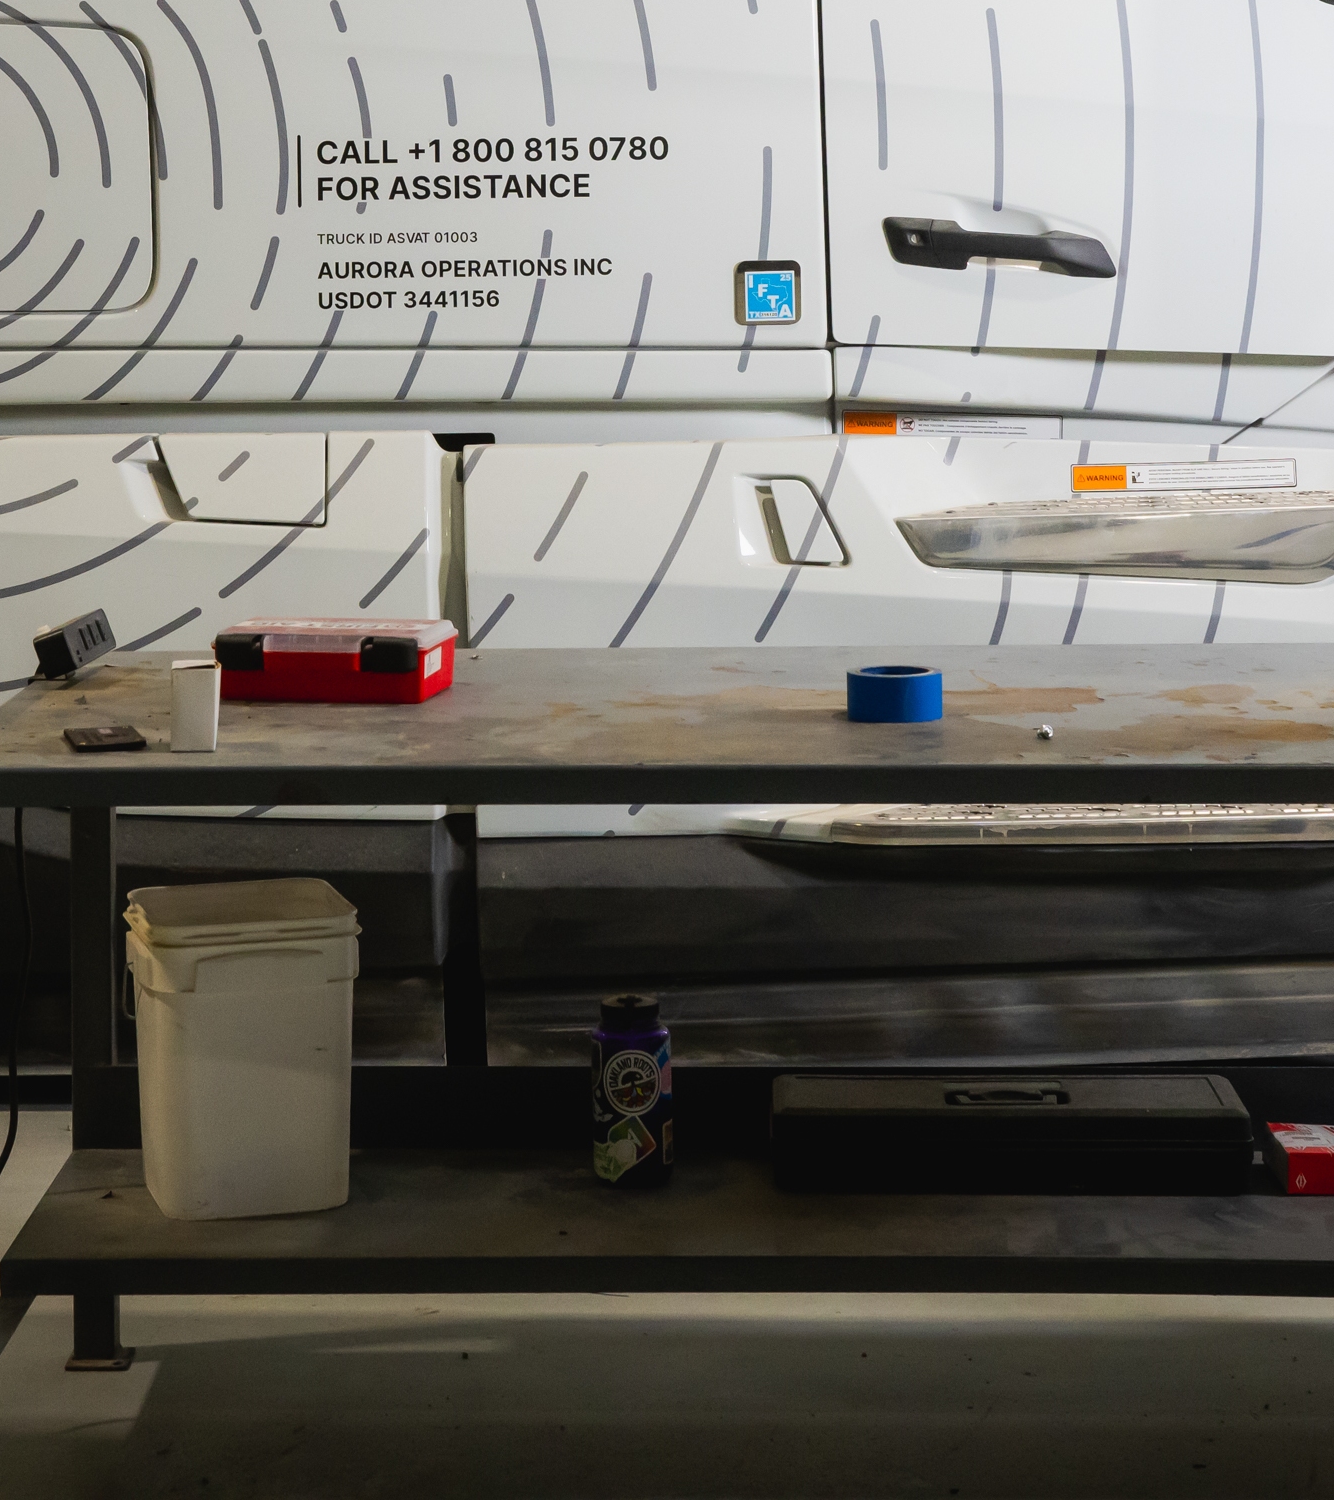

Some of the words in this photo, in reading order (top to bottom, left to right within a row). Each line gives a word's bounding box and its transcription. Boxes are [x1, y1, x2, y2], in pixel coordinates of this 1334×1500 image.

[316, 139, 398, 165] CALL
[407, 138, 443, 164] +1
[452, 137, 515, 163] 800
[524, 136, 579, 162] 815
[588, 135, 669, 161] 0780
[316, 176, 380, 202] FOR
[388, 173, 591, 199] ASSISTANCE
[317, 233, 366, 245] TRUCK
[368, 233, 383, 244] ID
[386, 232, 430, 244] ASVAT
[434, 231, 478, 243] 01003
[317, 260, 415, 280] AURORA
[420, 258, 567, 279] OPERATIONS
[572, 257, 613, 277] INC
[780, 274, 792, 282] 25
[317, 290, 397, 310] USDOT
[403, 289, 500, 309] 3441156
[856, 420, 893, 428] WARNING
[1086, 474, 1124, 482] WARNING
[608, 1057, 632, 1088] OAKLAND
[633, 1057, 656, 1079] ROOTS
